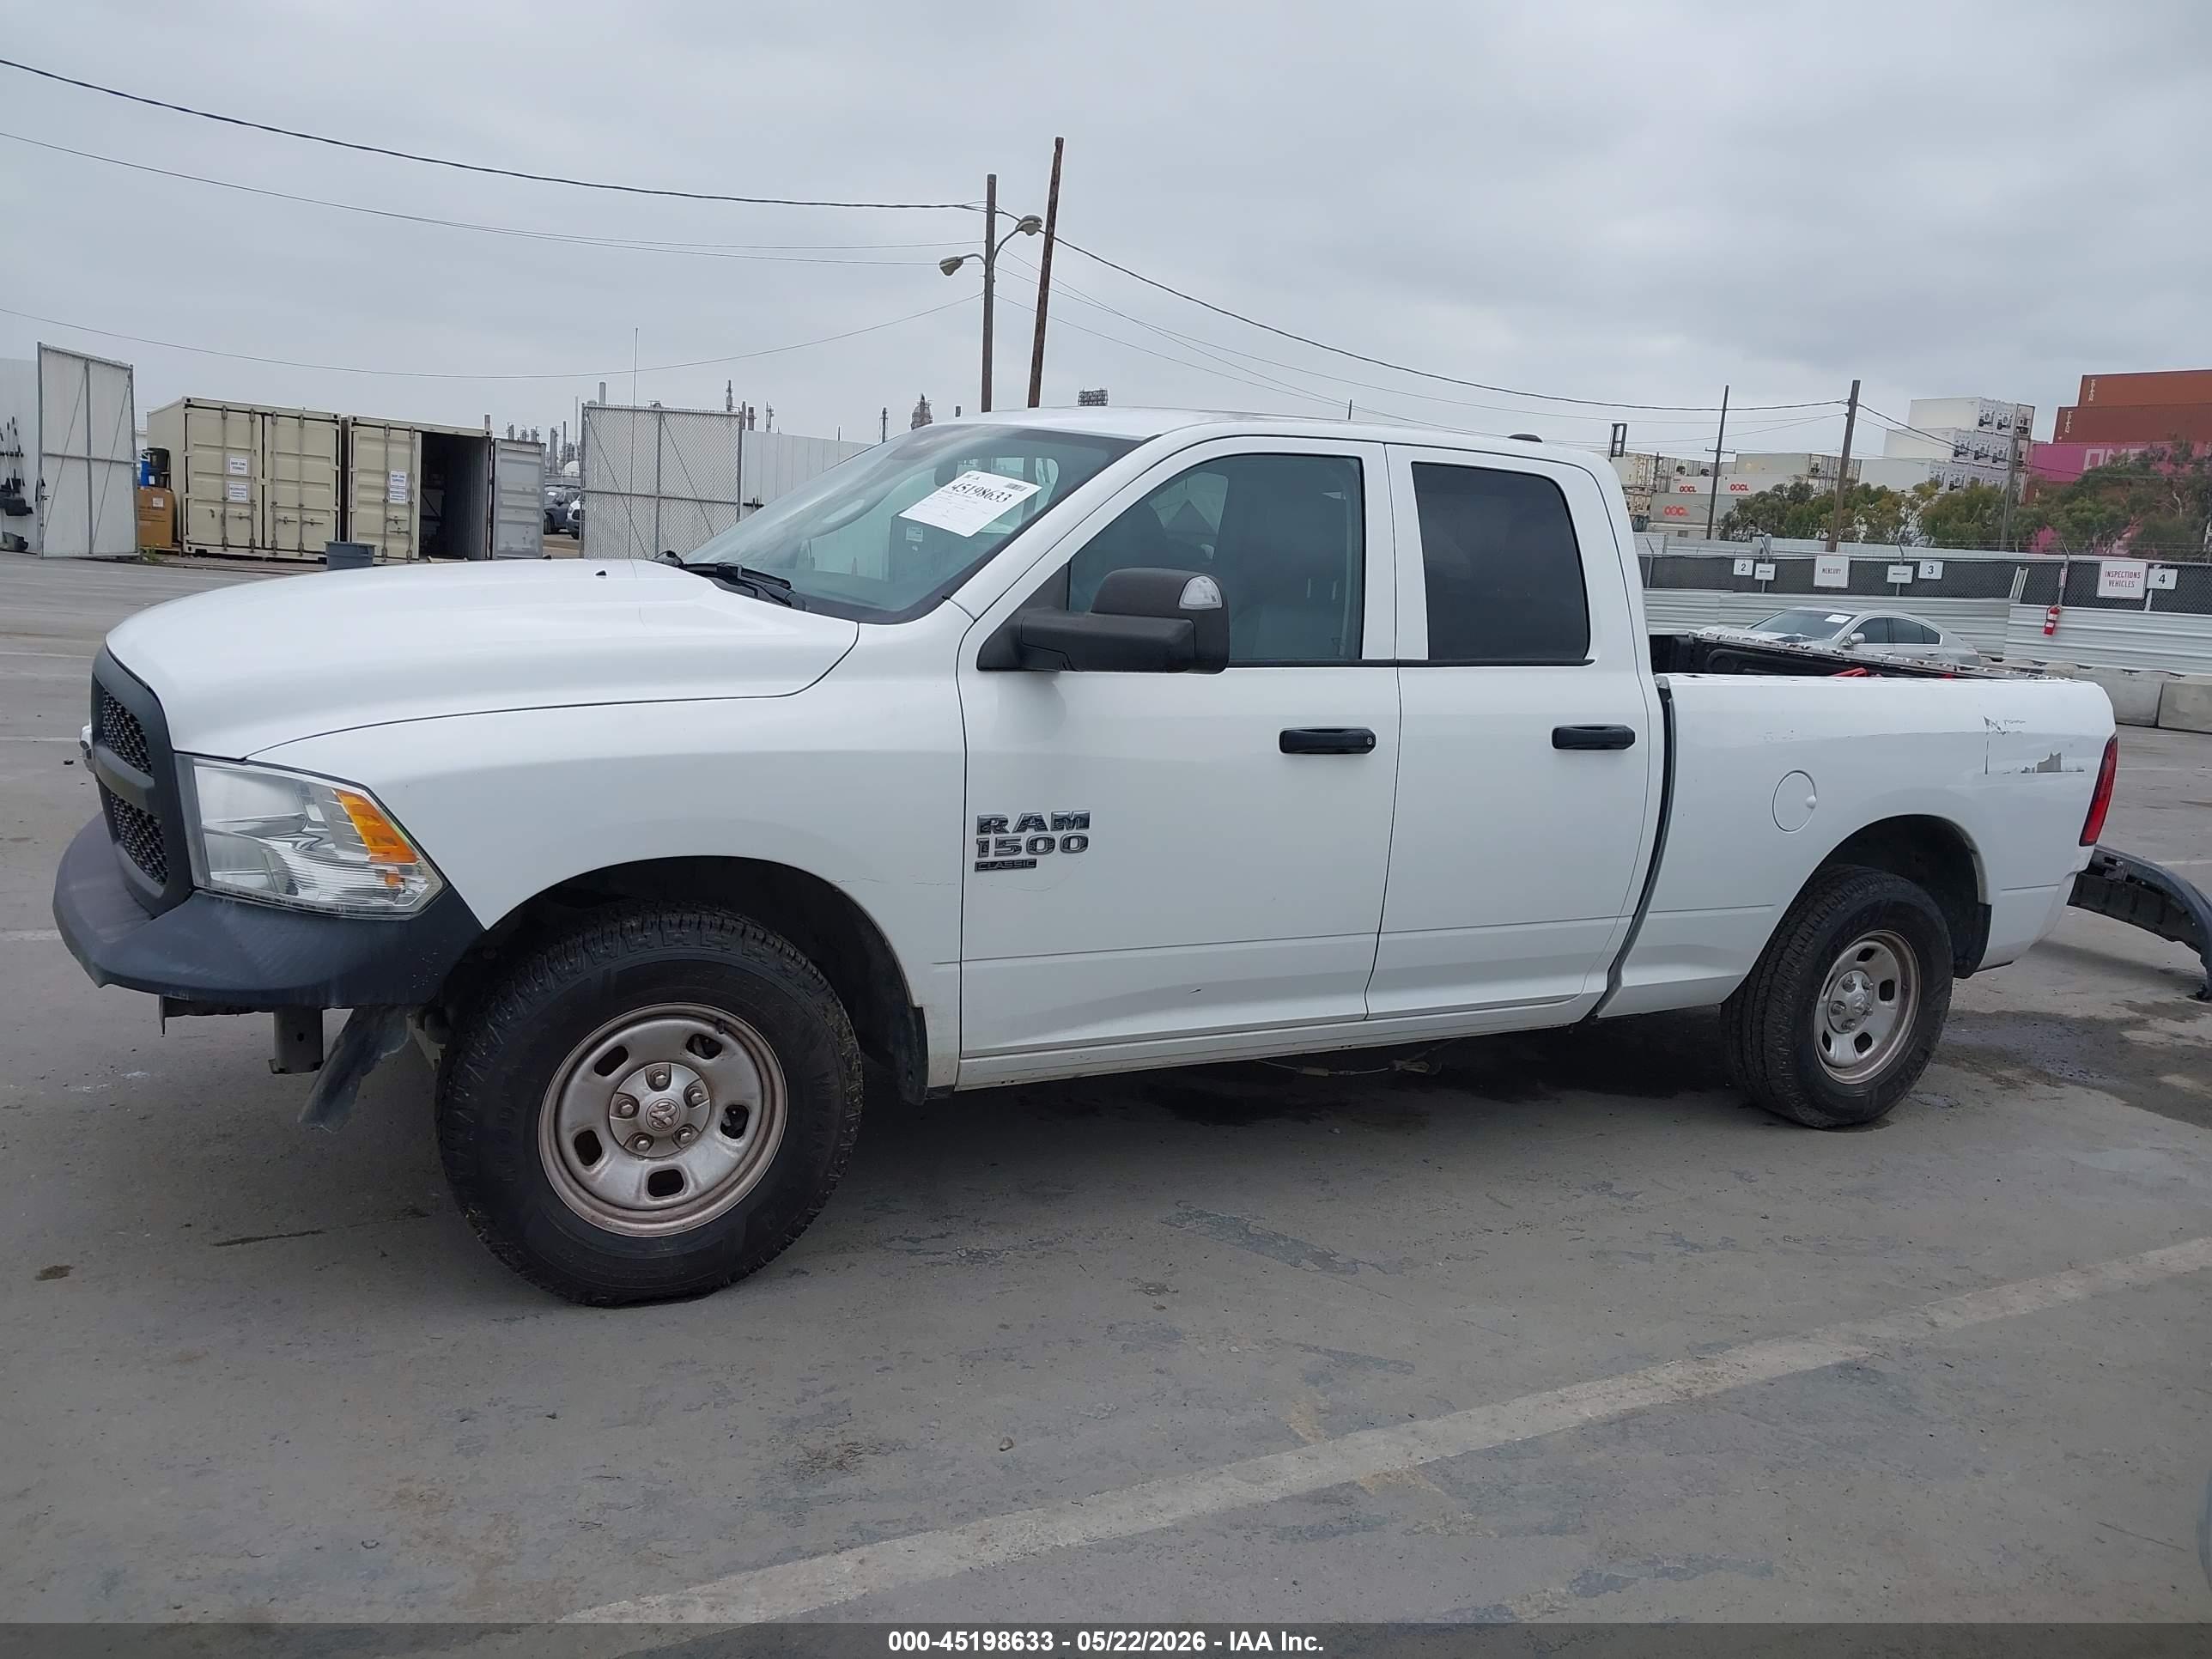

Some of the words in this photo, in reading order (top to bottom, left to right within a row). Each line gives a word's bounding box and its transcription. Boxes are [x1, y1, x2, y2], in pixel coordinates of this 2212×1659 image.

[951, 483, 1012, 502] 45198633
[1741, 563, 1746, 572] 2
[1928, 565, 1934, 574] 3
[2105, 570, 2141, 579] INSPECTIONS
[2158, 574, 2166, 584] 4
[2108, 580, 2135, 588] VEHICLES
[976, 810, 1090, 836] RAM
[975, 832, 1089, 858] 1500
[976, 860, 1036, 871] CLASSIC
